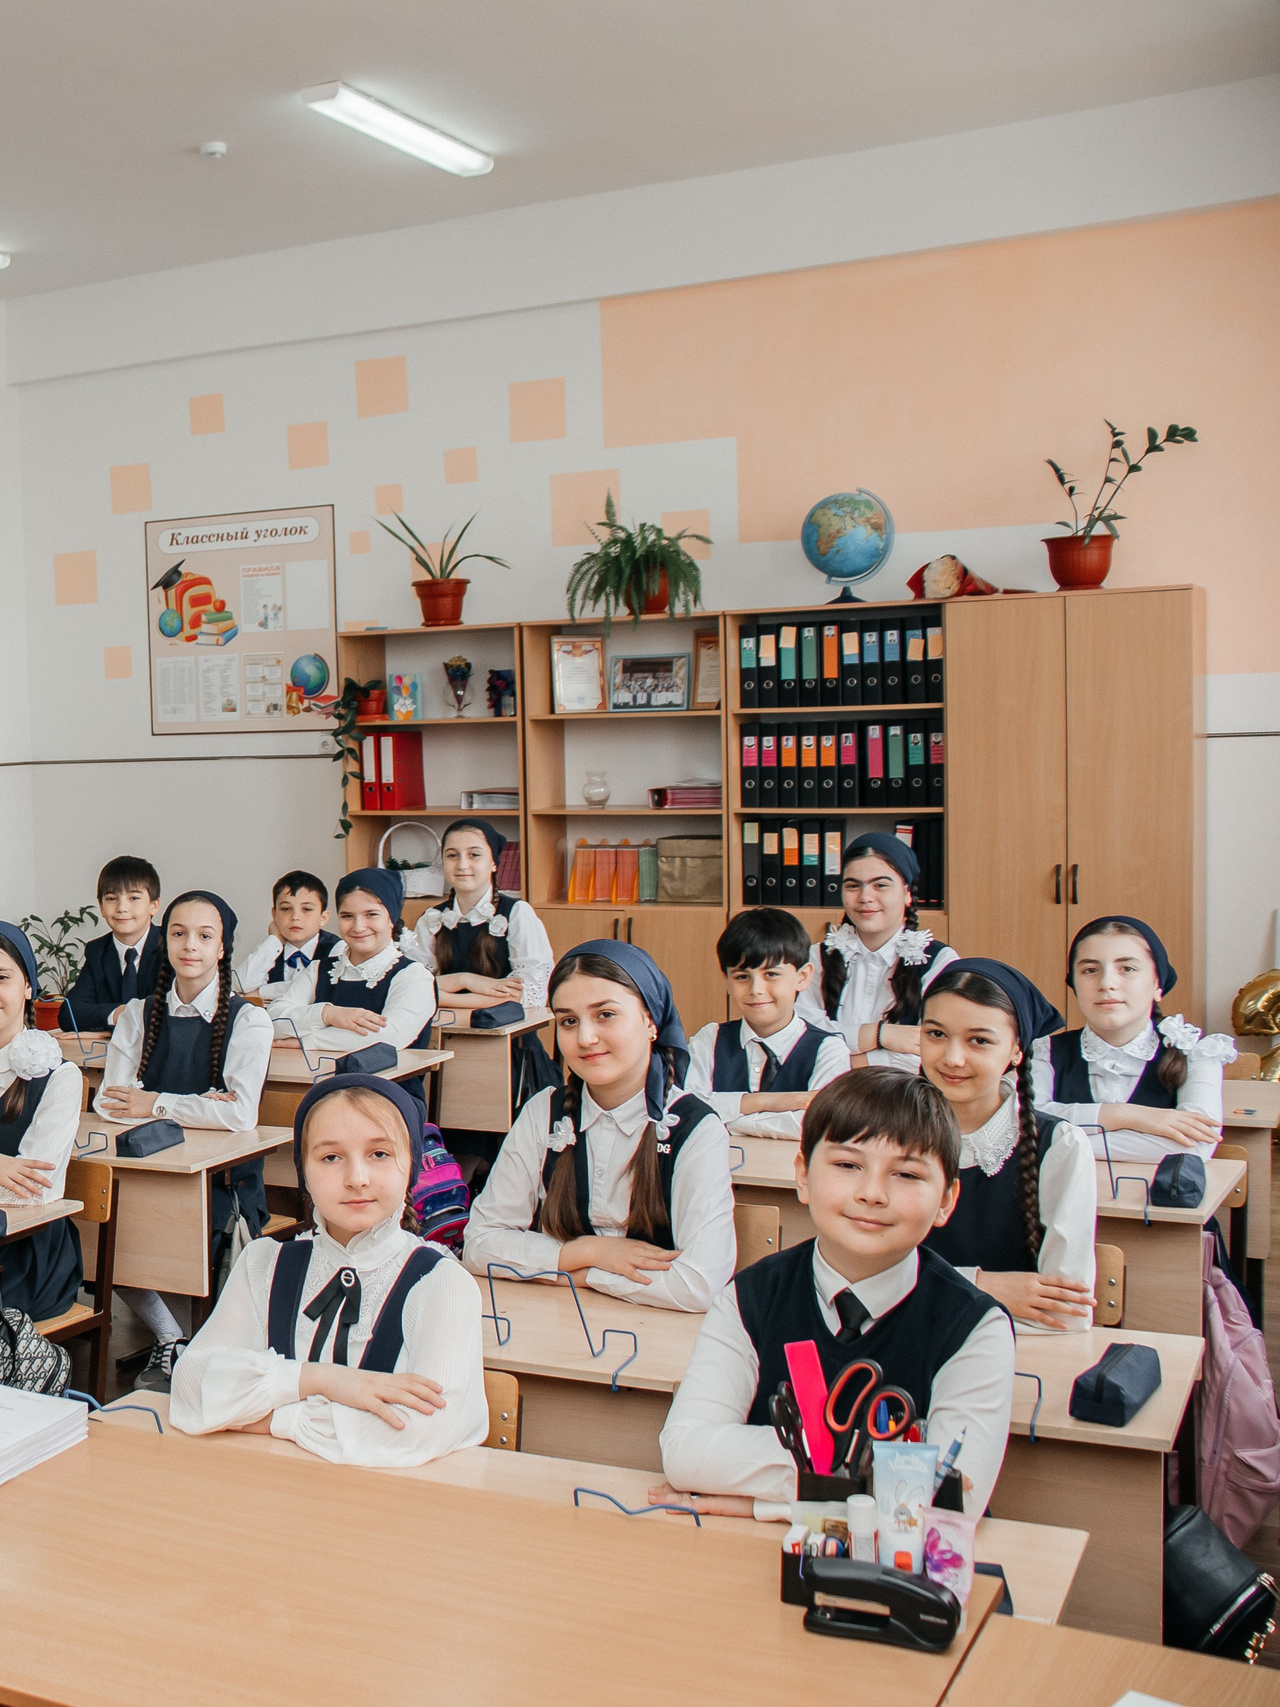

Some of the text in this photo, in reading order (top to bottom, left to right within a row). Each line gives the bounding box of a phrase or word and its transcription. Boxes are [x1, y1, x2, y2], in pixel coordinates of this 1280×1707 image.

[169, 524, 309, 547] Классный уголок
[657, 1143, 671, 1154] DG
